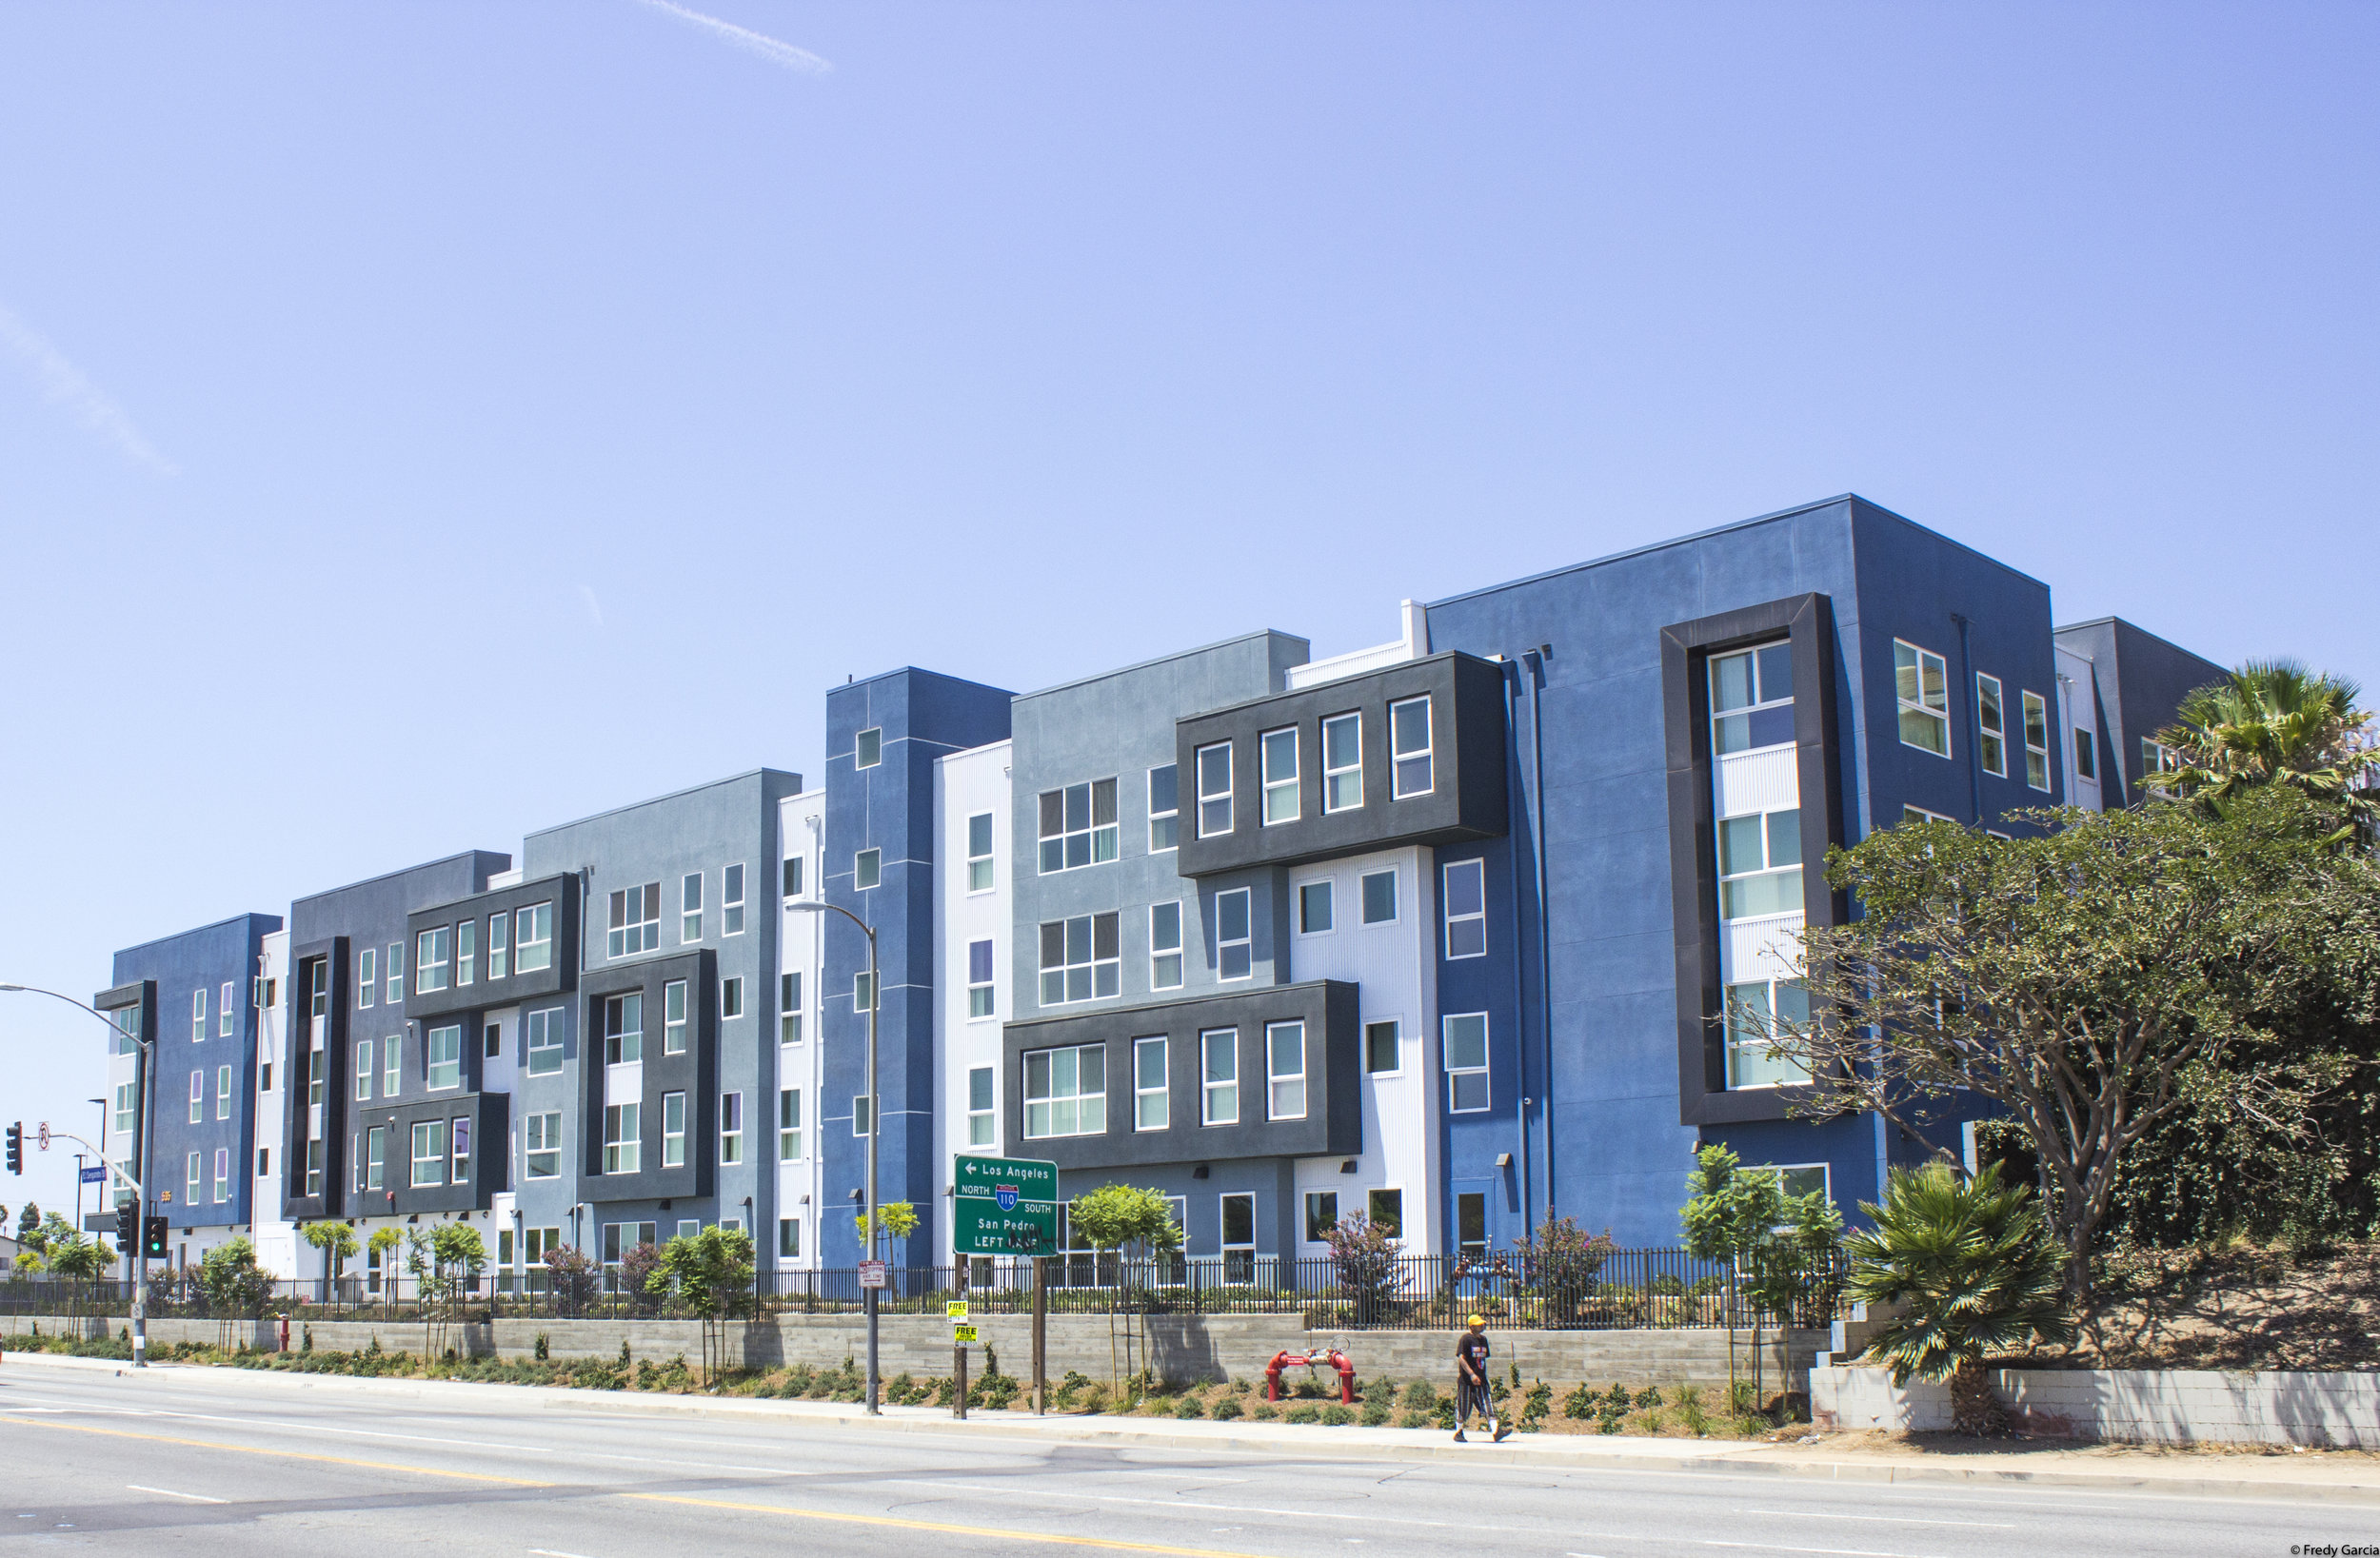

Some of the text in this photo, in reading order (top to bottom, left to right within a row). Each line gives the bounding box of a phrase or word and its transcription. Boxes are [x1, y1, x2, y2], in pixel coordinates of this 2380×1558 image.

[982, 1164, 1048, 1180] Los Angeles
[962, 1185, 989, 1194] NORTH
[1001, 1194, 1015, 1205] 110
[1024, 1203, 1051, 1213] SOUTH
[978, 1218, 1035, 1231] San Pedro
[975, 1235, 1004, 1248] LEFT
[956, 1327, 977, 1335] FREE
